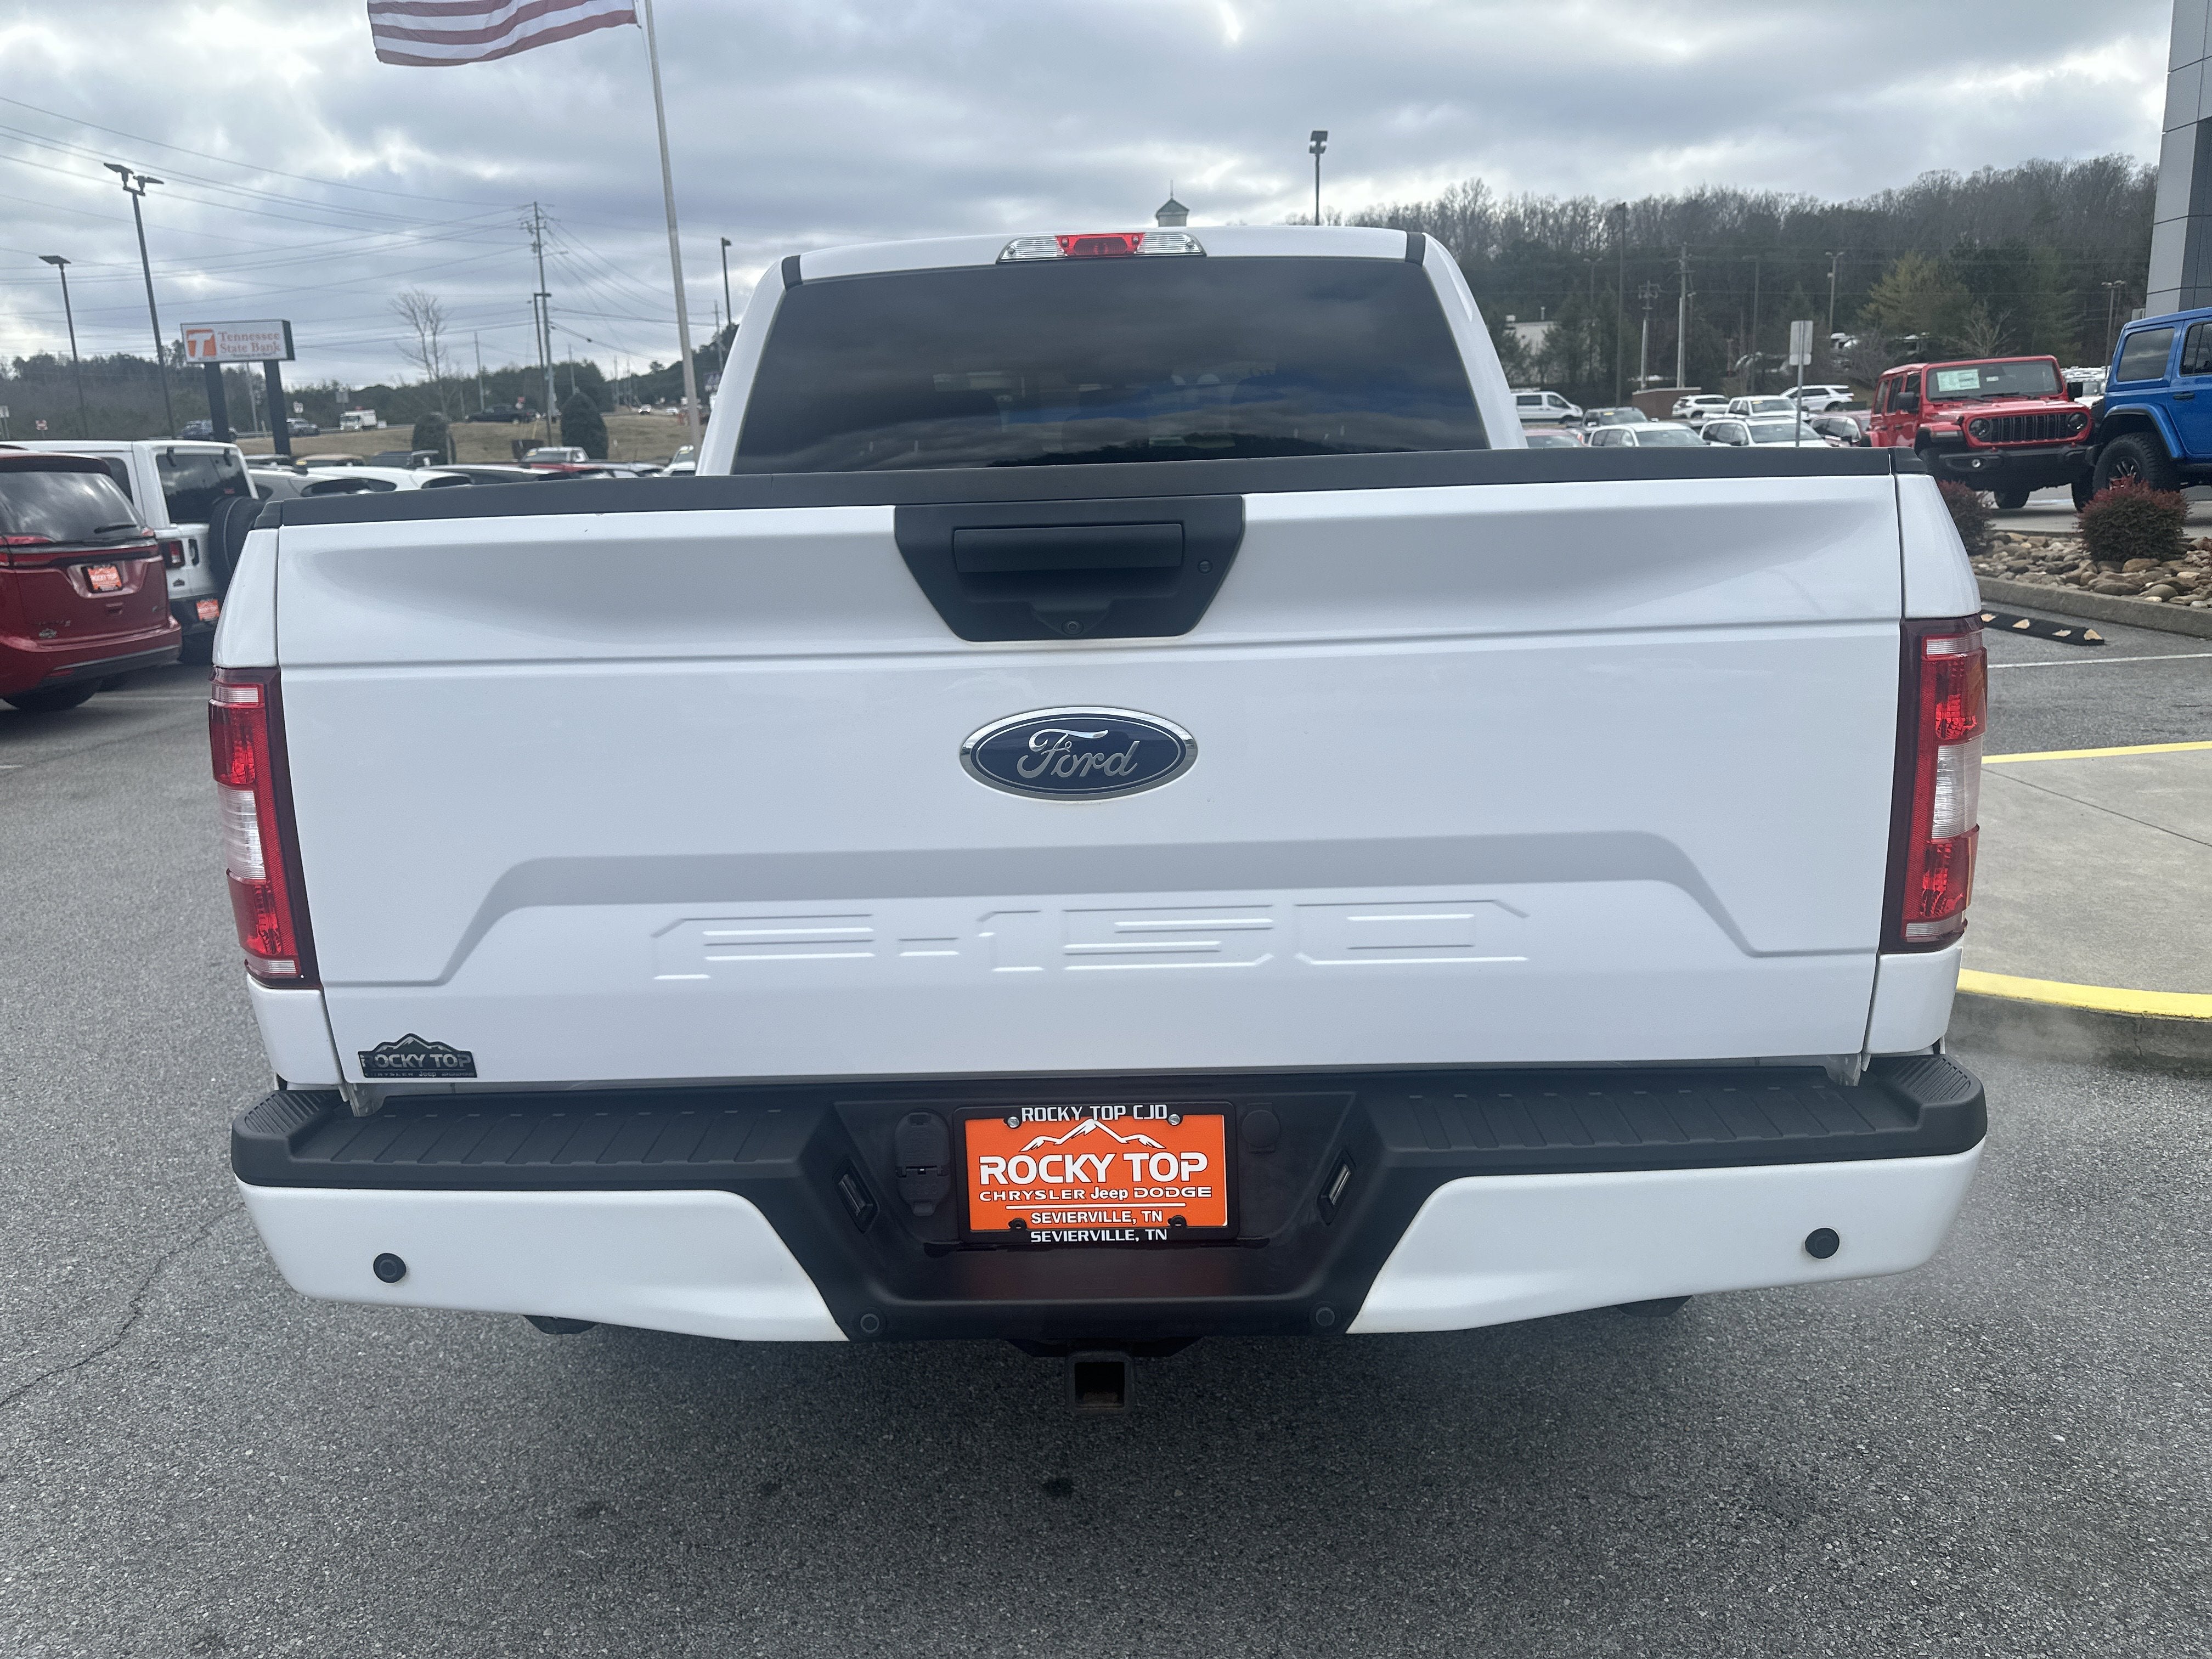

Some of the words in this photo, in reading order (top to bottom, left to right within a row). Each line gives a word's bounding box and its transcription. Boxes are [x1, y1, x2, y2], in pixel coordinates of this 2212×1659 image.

[218, 331, 280, 341] Tennessee
[220, 342, 247, 353] State
[251, 342, 280, 352] Bank
[1017, 728, 1140, 778] Ford
[651, 898, 1530, 979] F-150
[430, 1053, 472, 1068] TOP
[1021, 1106, 1083, 1122] ROCKY
[1090, 1104, 1126, 1121] TOP
[1132, 1104, 1168, 1120] CJD
[979, 1153, 1116, 1185] ROCKY
[1122, 1151, 1209, 1183] TOP
[979, 1189, 1085, 1202] CHRYSLER
[1090, 1186, 1128, 1201] Jeep
[1133, 1186, 1212, 1199] DODGE
[1030, 1210, 1137, 1225] SEVIERVILLE,
[1141, 1210, 1163, 1223] TN
[1030, 1229, 1139, 1243] SEVIERVILLE,
[1147, 1228, 1167, 1242] TN
